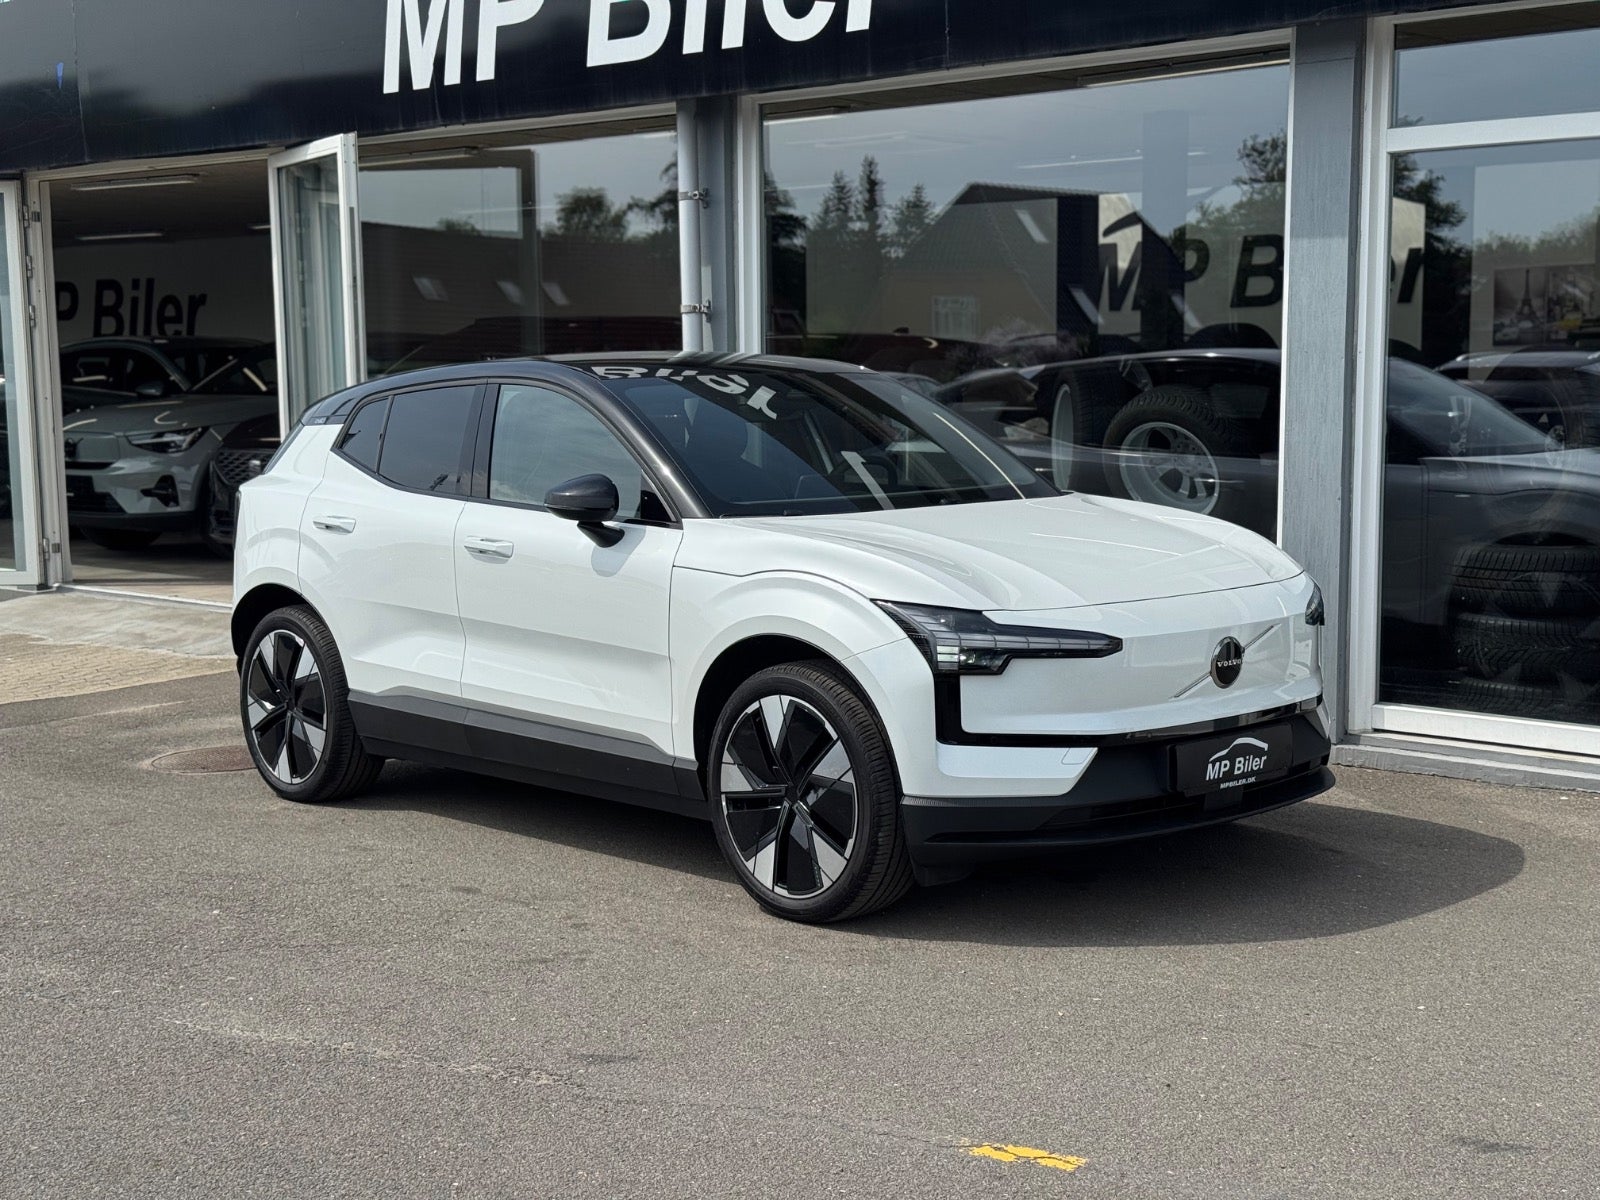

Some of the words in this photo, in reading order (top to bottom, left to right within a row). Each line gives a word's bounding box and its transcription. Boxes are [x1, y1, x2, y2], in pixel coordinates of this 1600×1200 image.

[93, 278, 208, 337] Biler
[1217, 659, 1241, 668] VOLVO
[1206, 760, 1230, 780] MP
[1233, 754, 1267, 775] Biler
[1220, 776, 1256, 790] MPBILER.DK
